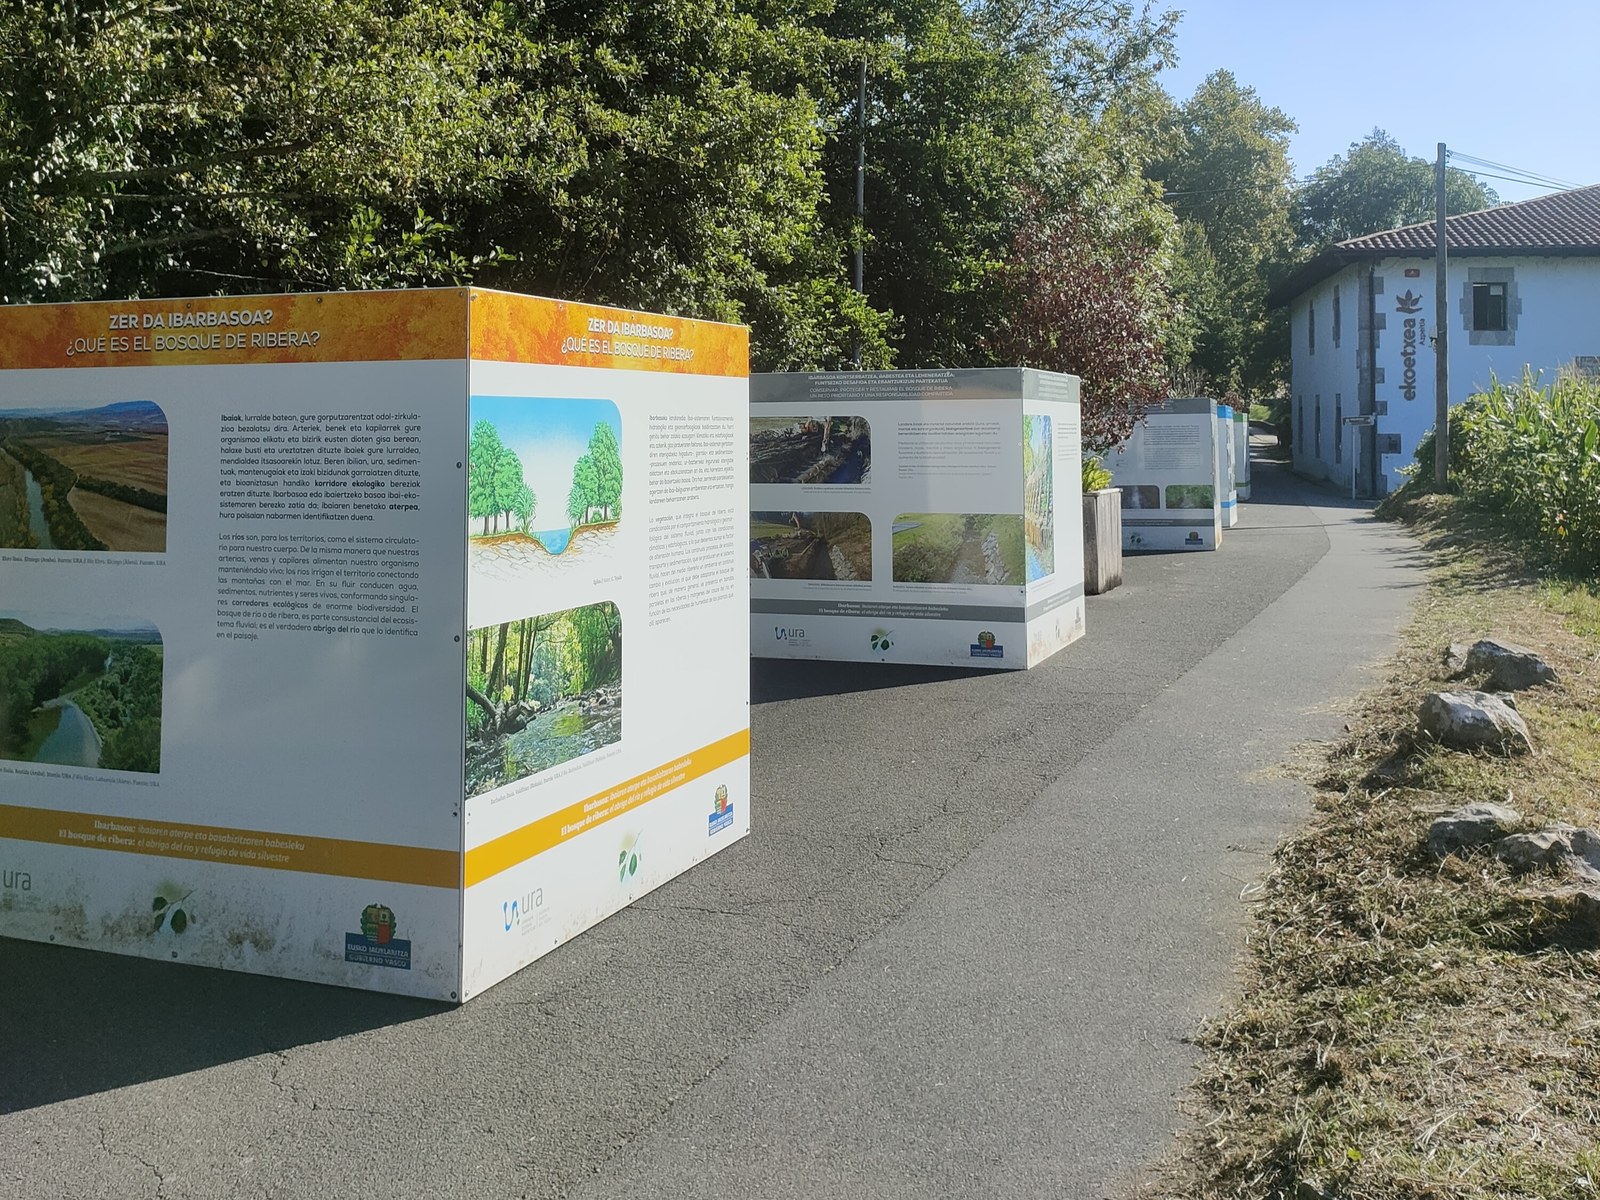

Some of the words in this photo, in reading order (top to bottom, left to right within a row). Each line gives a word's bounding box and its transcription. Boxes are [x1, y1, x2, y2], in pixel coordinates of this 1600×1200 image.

[109, 314, 139, 329] ZER
[143, 313, 164, 329] DA
[168, 309, 273, 328] IBARBASOA?
[588, 318, 605, 332] ZER
[607, 320, 620, 335] DA
[621, 322, 674, 340] IBARBASOA?
[66, 334, 106, 356] ¿QUÉ
[110, 336, 129, 351] ES
[133, 335, 151, 351] EL
[155, 333, 220, 351] BOSQUE
[225, 332, 246, 348] DE
[251, 330, 320, 348] RIBERA?
[561, 335, 587, 353] ¿QUÉ
[588, 339, 600, 354] ES
[602, 341, 613, 354] EL
[614, 342, 649, 358] BOSQUE
[650, 344, 661, 358] DE
[663, 346, 694, 361] RIBERA?
[1399, 318, 1416, 401] ekoetxea
[299, 415, 315, 423] gure
[292, 424, 322, 432] Arteriek,
[365, 424, 400, 432] kapilarrek
[404, 425, 420, 433] gure
[244, 446, 261, 454] busti
[317, 446, 341, 454] dituzte
[367, 448, 383, 456] gure
[386, 446, 421, 454] lurraldea,
[220, 468, 237, 476] tuak,
[316, 468, 349, 476] bizidunak
[393, 469, 421, 477] dituzte,
[314, 479, 347, 487] korridore
[351, 480, 385, 489] ekologiko
[307, 501, 320, 509] da;
[353, 502, 386, 510] benetako
[384, 536, 420, 544] circulato-
[278, 556, 309, 565] capilares
[312, 557, 347, 565] alimentan
[380, 560, 419, 569] organismo
[268, 566, 285, 574] vivo;
[285, 567, 295, 575] los
[311, 568, 334, 578] irrigan
[343, 569, 375, 577] territorio
[272, 600, 308, 610] ecológicos
[235, 620, 258, 629] fluvial;
[275, 623, 311, 631] verdadero
[312, 624, 336, 634] abrigo
[384, 627, 417, 636] identifica
[788, 628, 805, 638] ura
[3, 869, 31, 891] ura
[522, 887, 543, 914] ura
